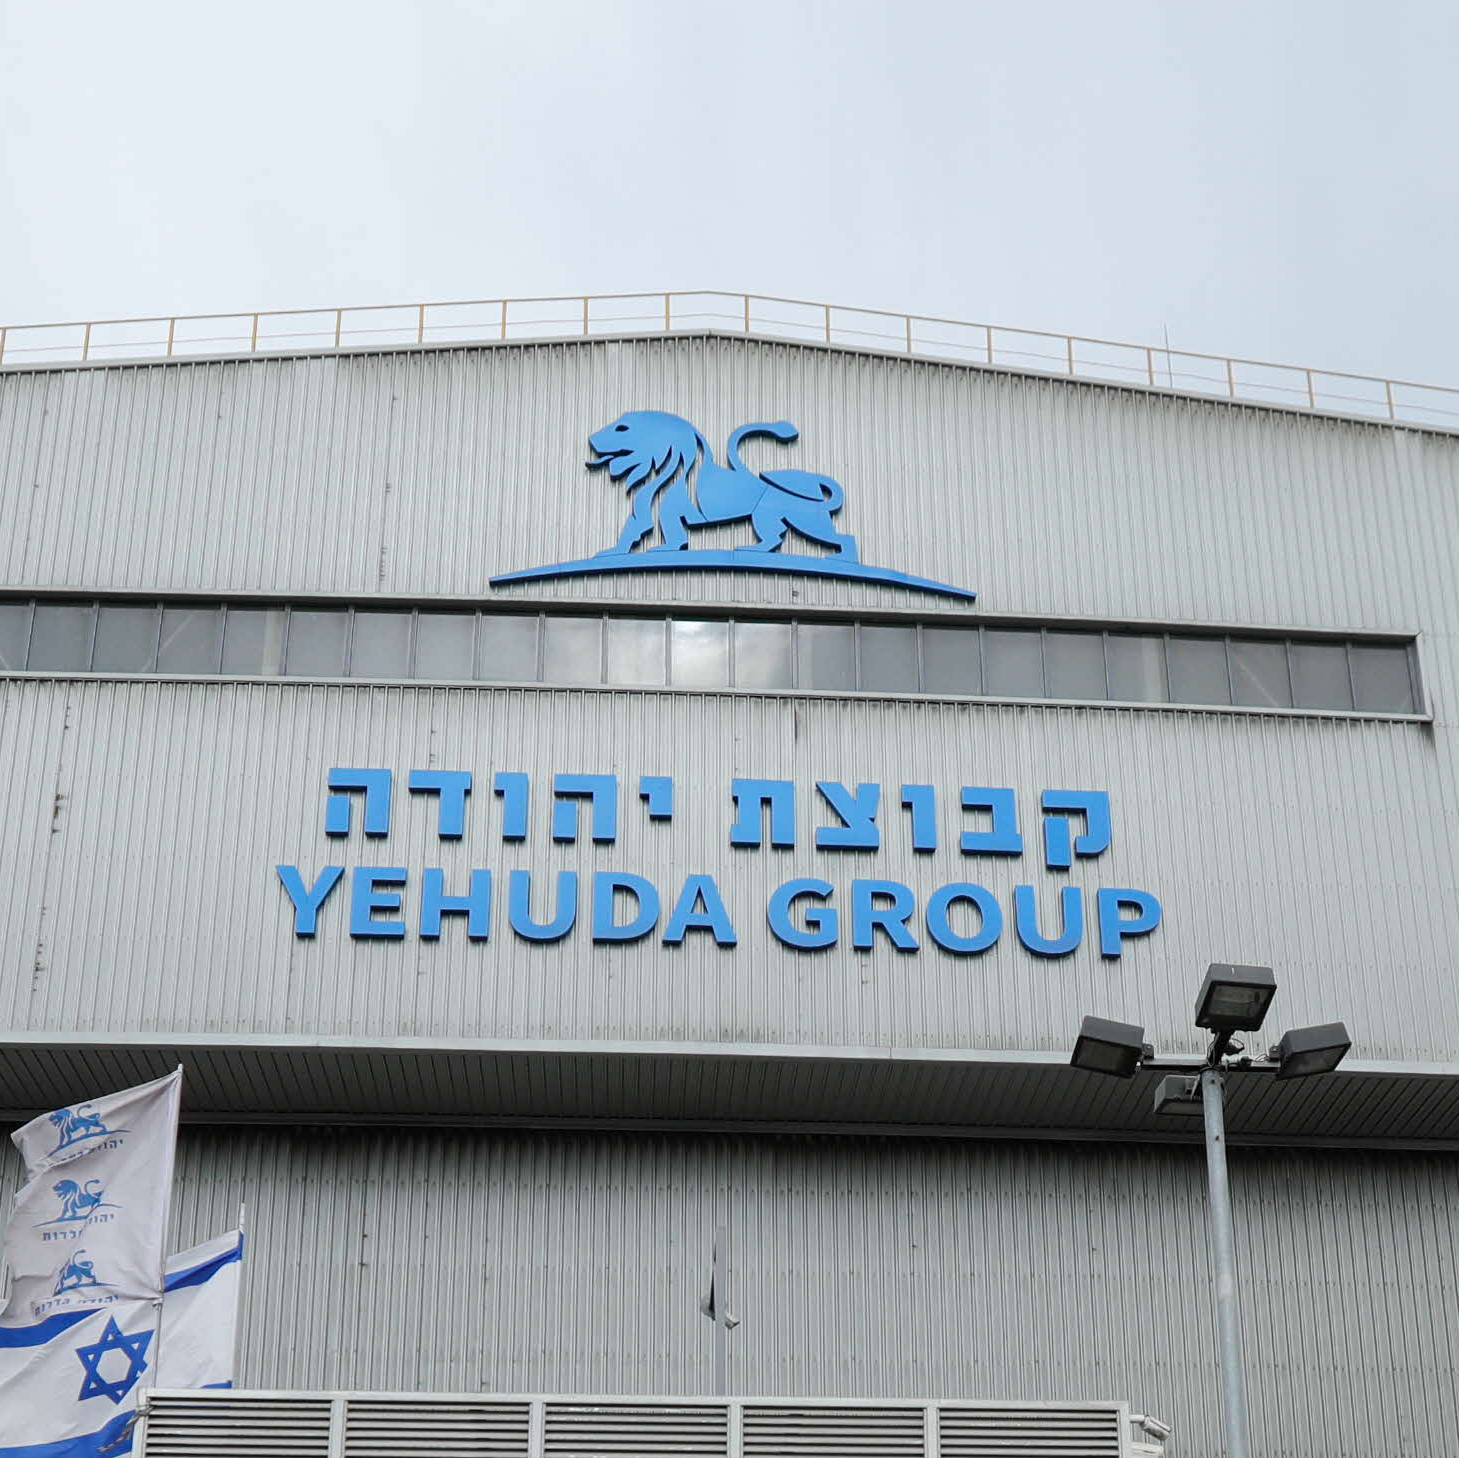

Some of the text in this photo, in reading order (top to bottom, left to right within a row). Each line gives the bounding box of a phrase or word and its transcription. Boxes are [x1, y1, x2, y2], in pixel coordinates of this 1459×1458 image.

[325, 767, 1113, 869] קבוצת יהודה
[276, 864, 1163, 957] YEHUDA GROUP
